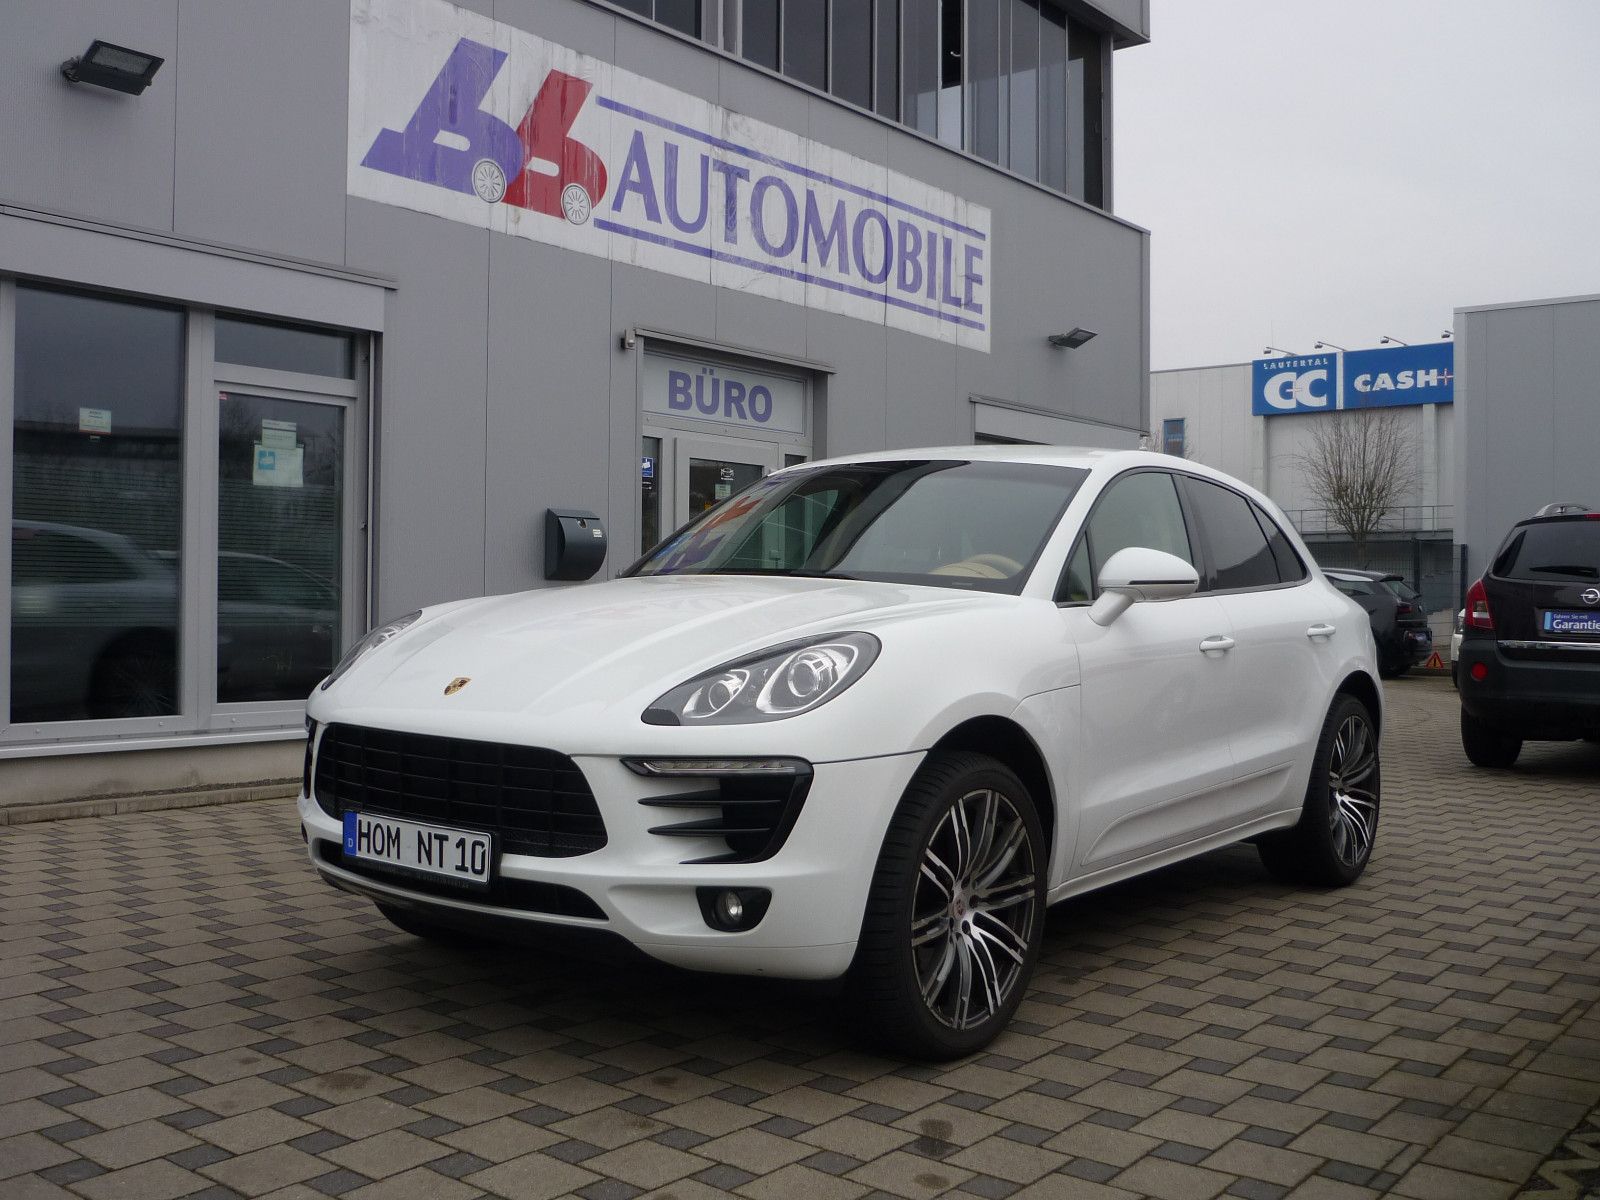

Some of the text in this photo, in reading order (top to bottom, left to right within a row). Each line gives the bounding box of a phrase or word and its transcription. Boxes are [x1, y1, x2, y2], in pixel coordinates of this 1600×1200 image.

[611, 129, 983, 316] AUTOMOBILE
[1263, 357, 1329, 370] LAUTERTAL
[668, 367, 773, 423] BÜRO
[357, 819, 486, 875] HOM NT 10
